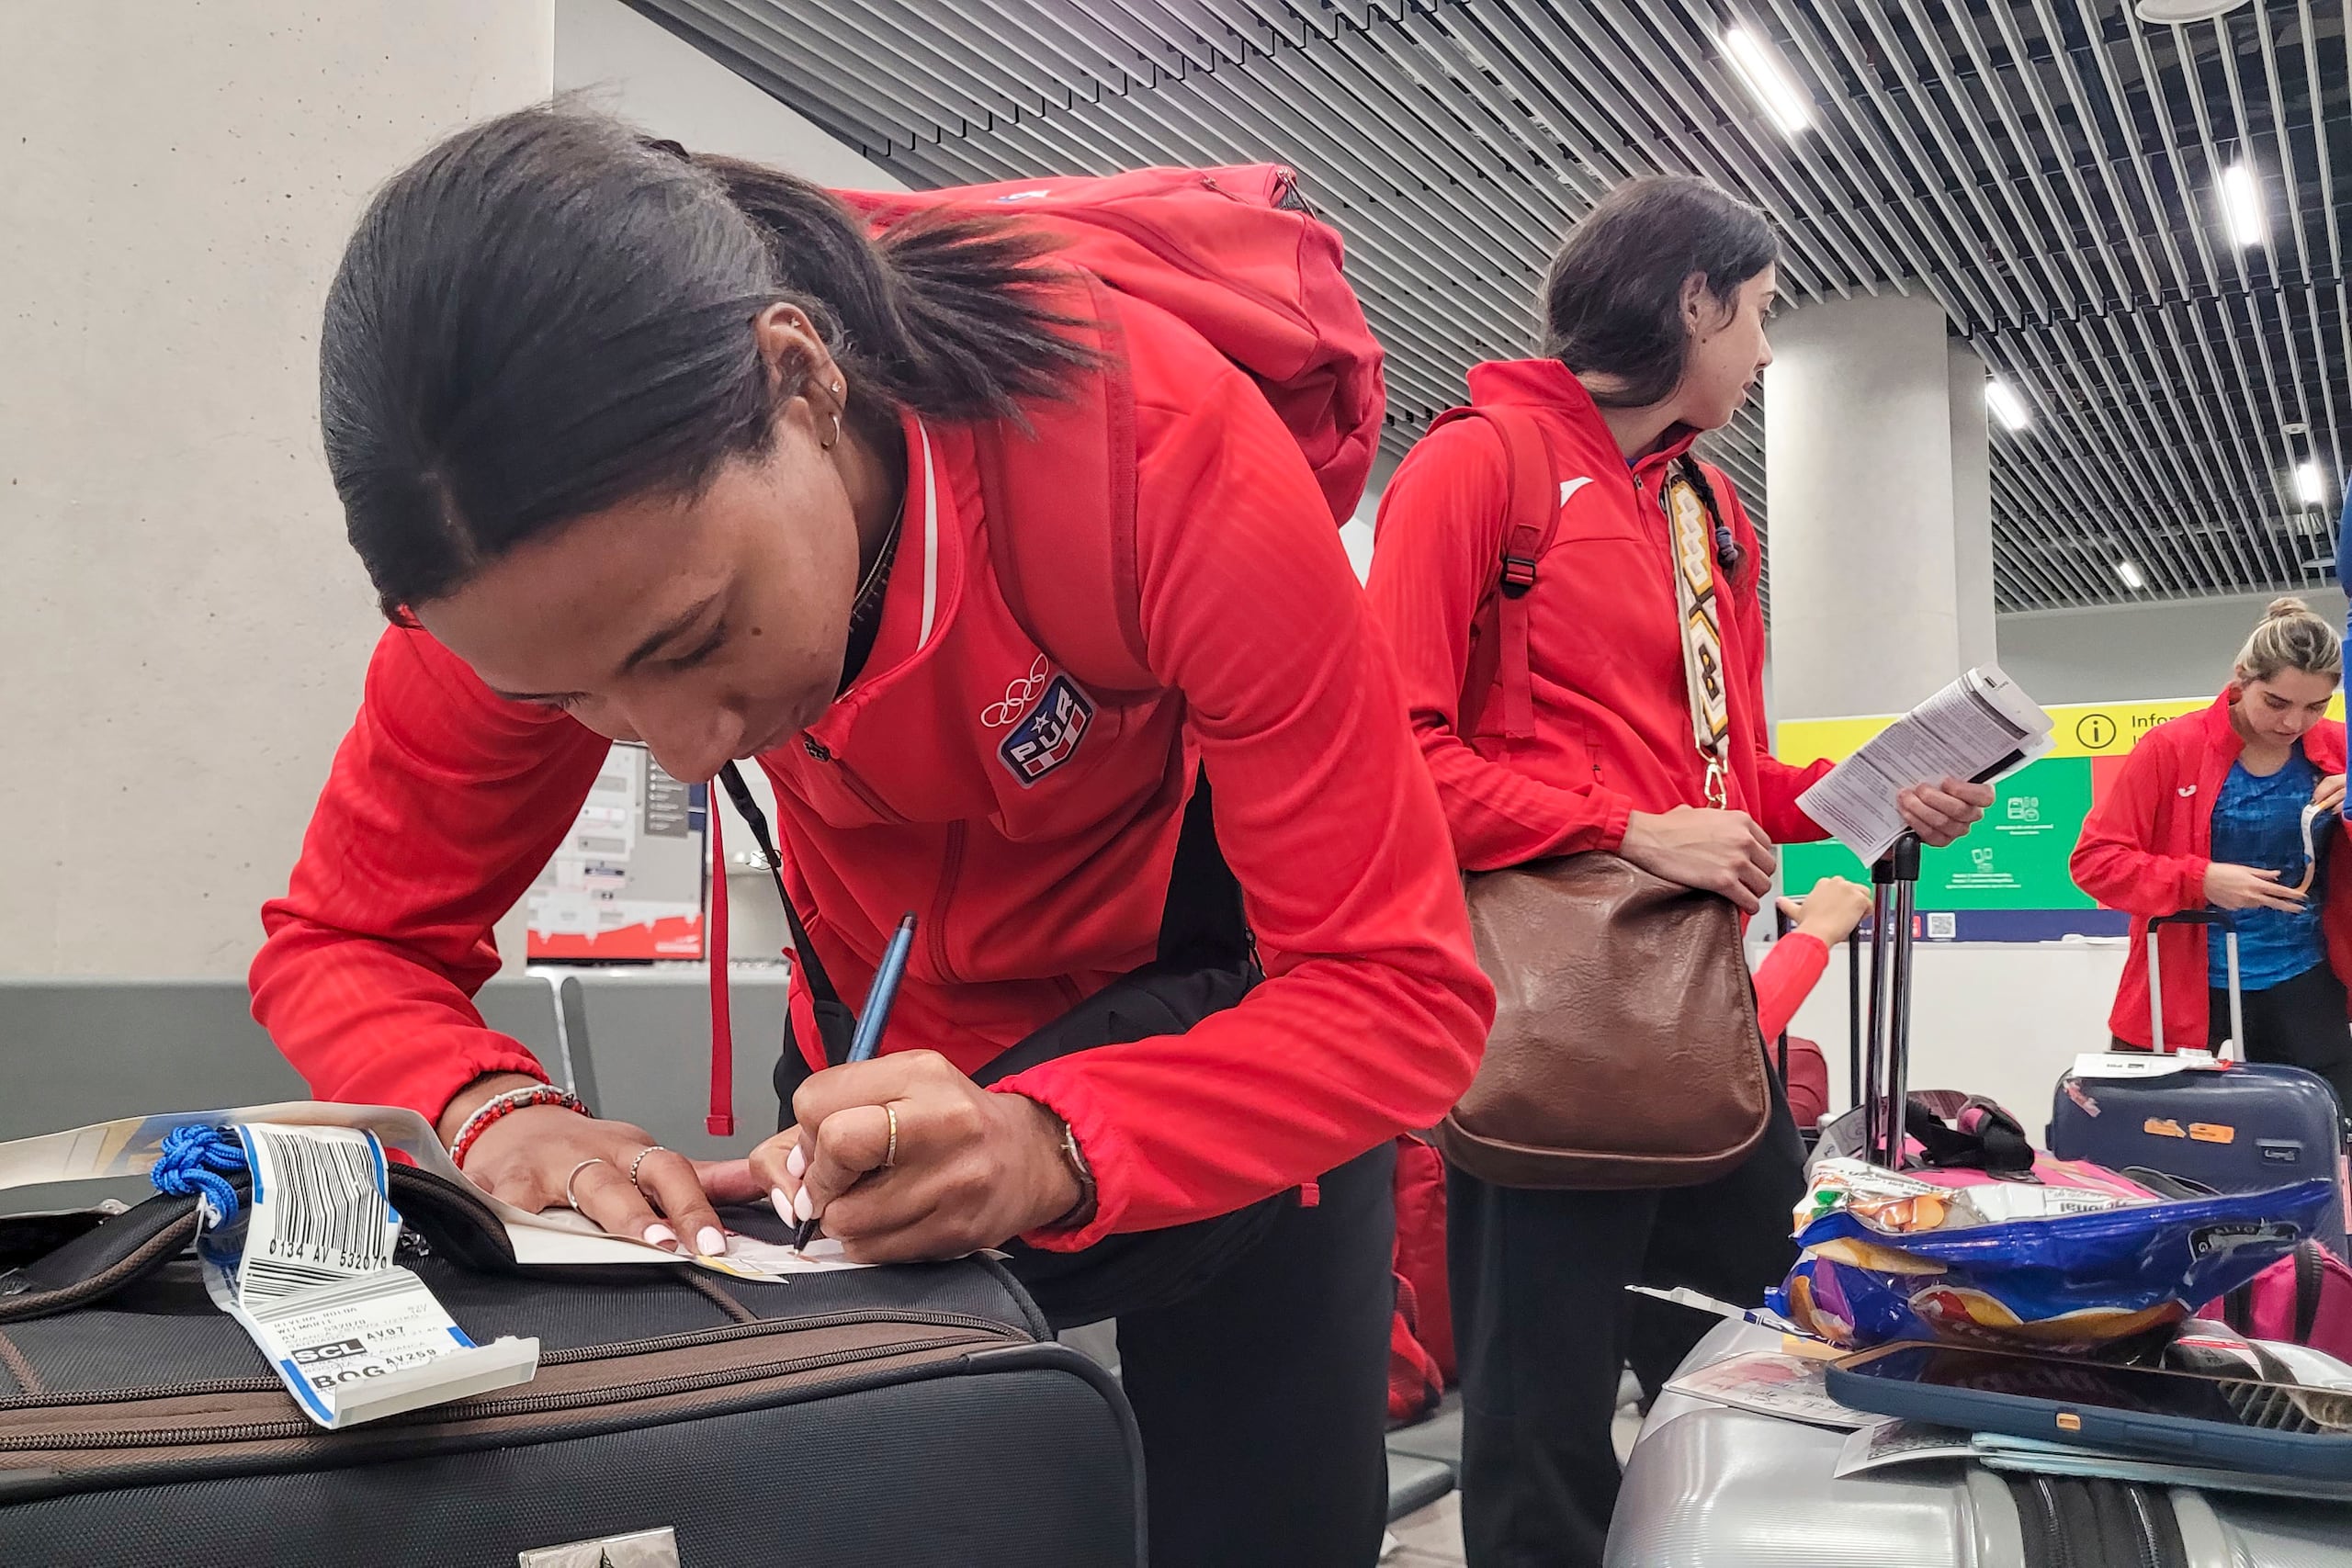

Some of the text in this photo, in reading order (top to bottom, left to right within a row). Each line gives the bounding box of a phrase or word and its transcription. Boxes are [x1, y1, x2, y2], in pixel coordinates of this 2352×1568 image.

[1011, 686, 1072, 761] PUR
[269, 1238, 387, 1270] 0134 AV 532070
[294, 1343, 366, 1363] SCL
[311, 1365, 387, 1389] BOG
